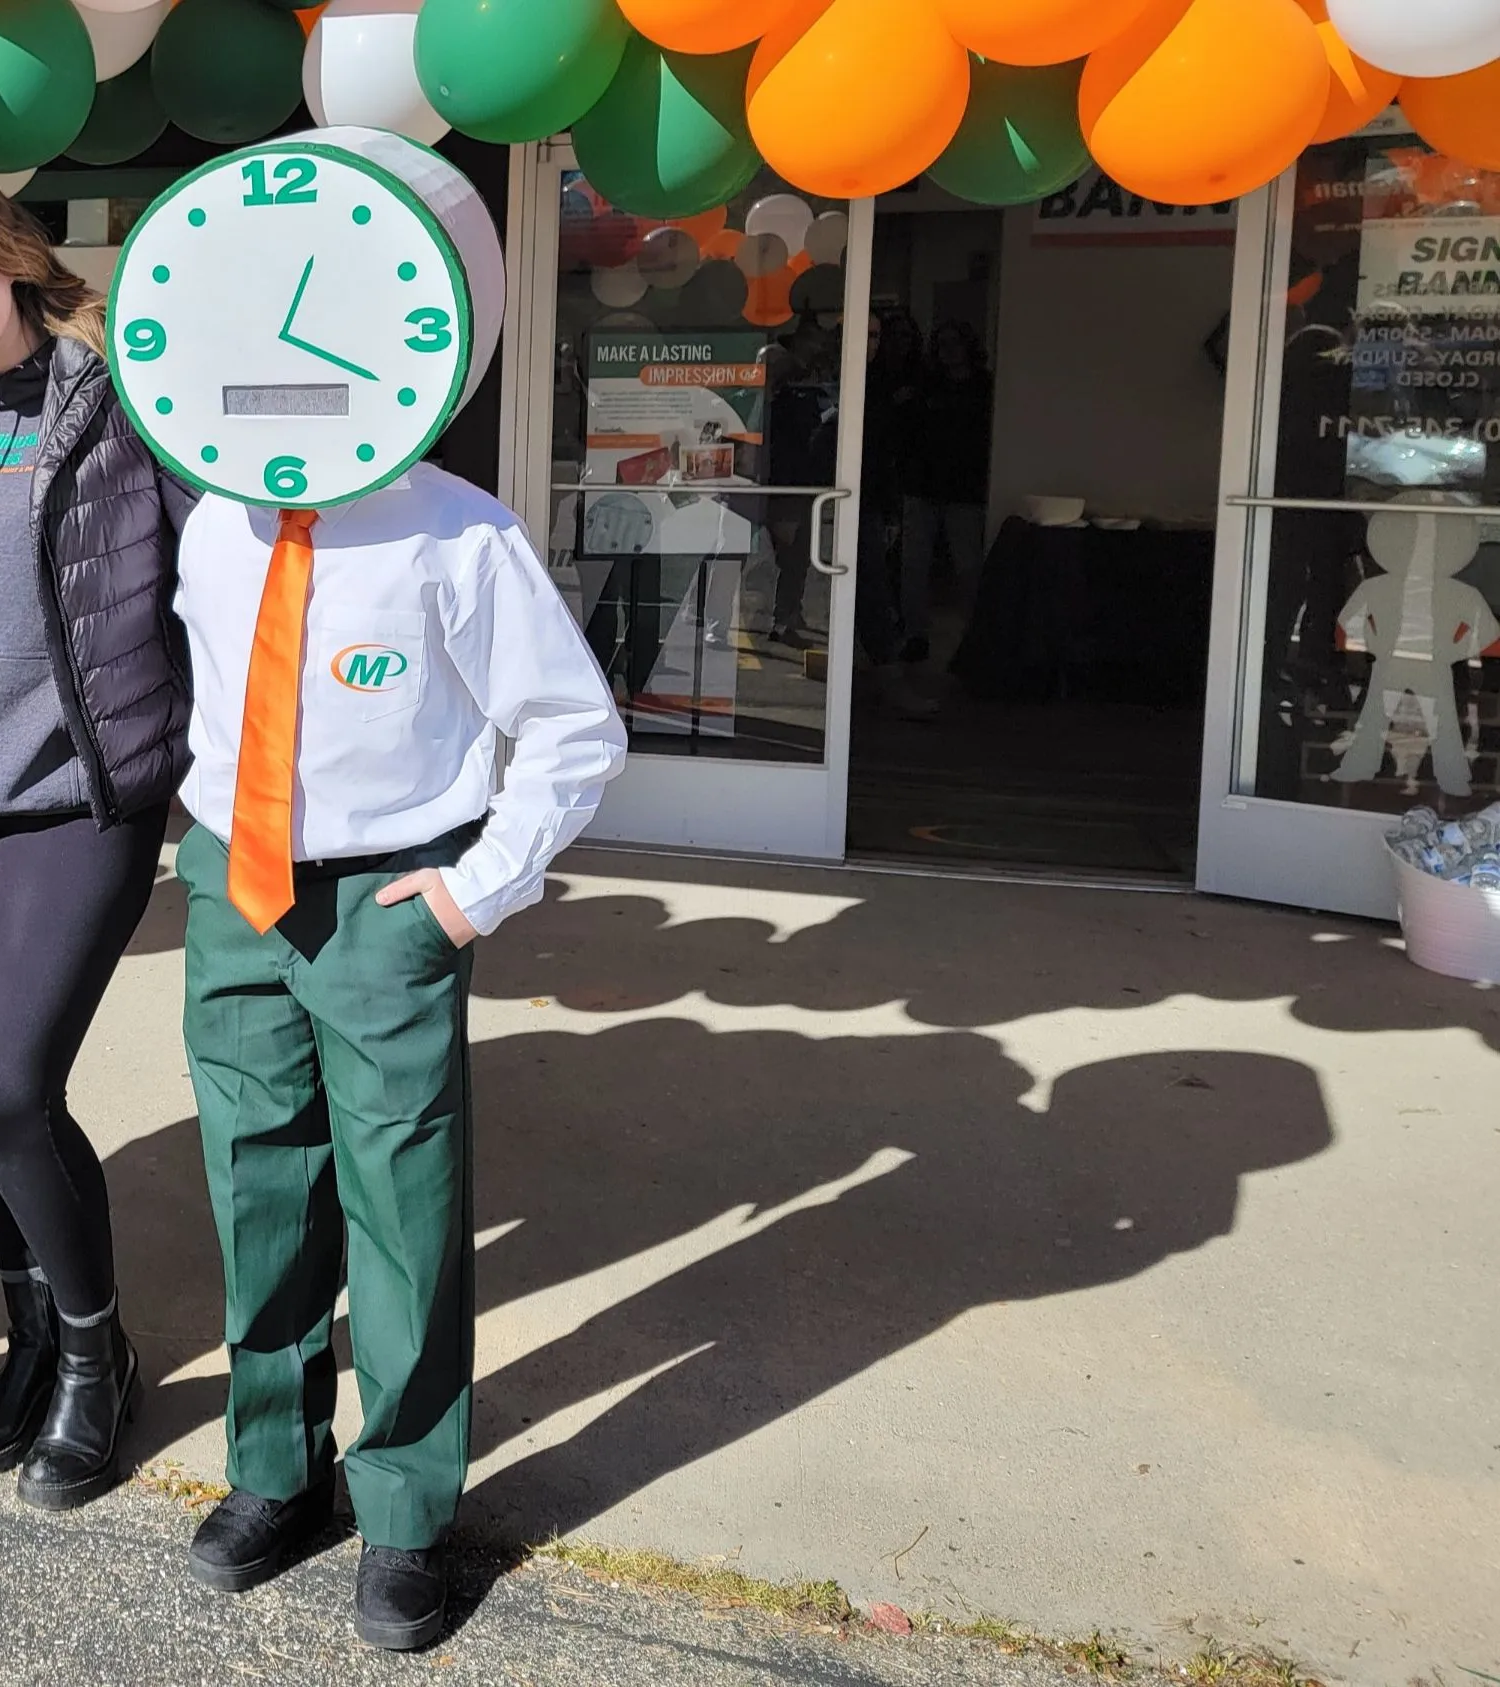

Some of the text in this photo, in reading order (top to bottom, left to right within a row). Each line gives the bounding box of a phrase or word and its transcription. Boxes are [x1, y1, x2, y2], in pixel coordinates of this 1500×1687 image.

[241, 157, 318, 207] 12
[123, 318, 167, 362] 9
[403, 307, 452, 353] 3
[597, 345, 712, 362] MAKE A LASTING
[649, 367, 736, 384] IMPRESSION
[263, 456, 308, 498] 6
[345, 650, 408, 687] MP
